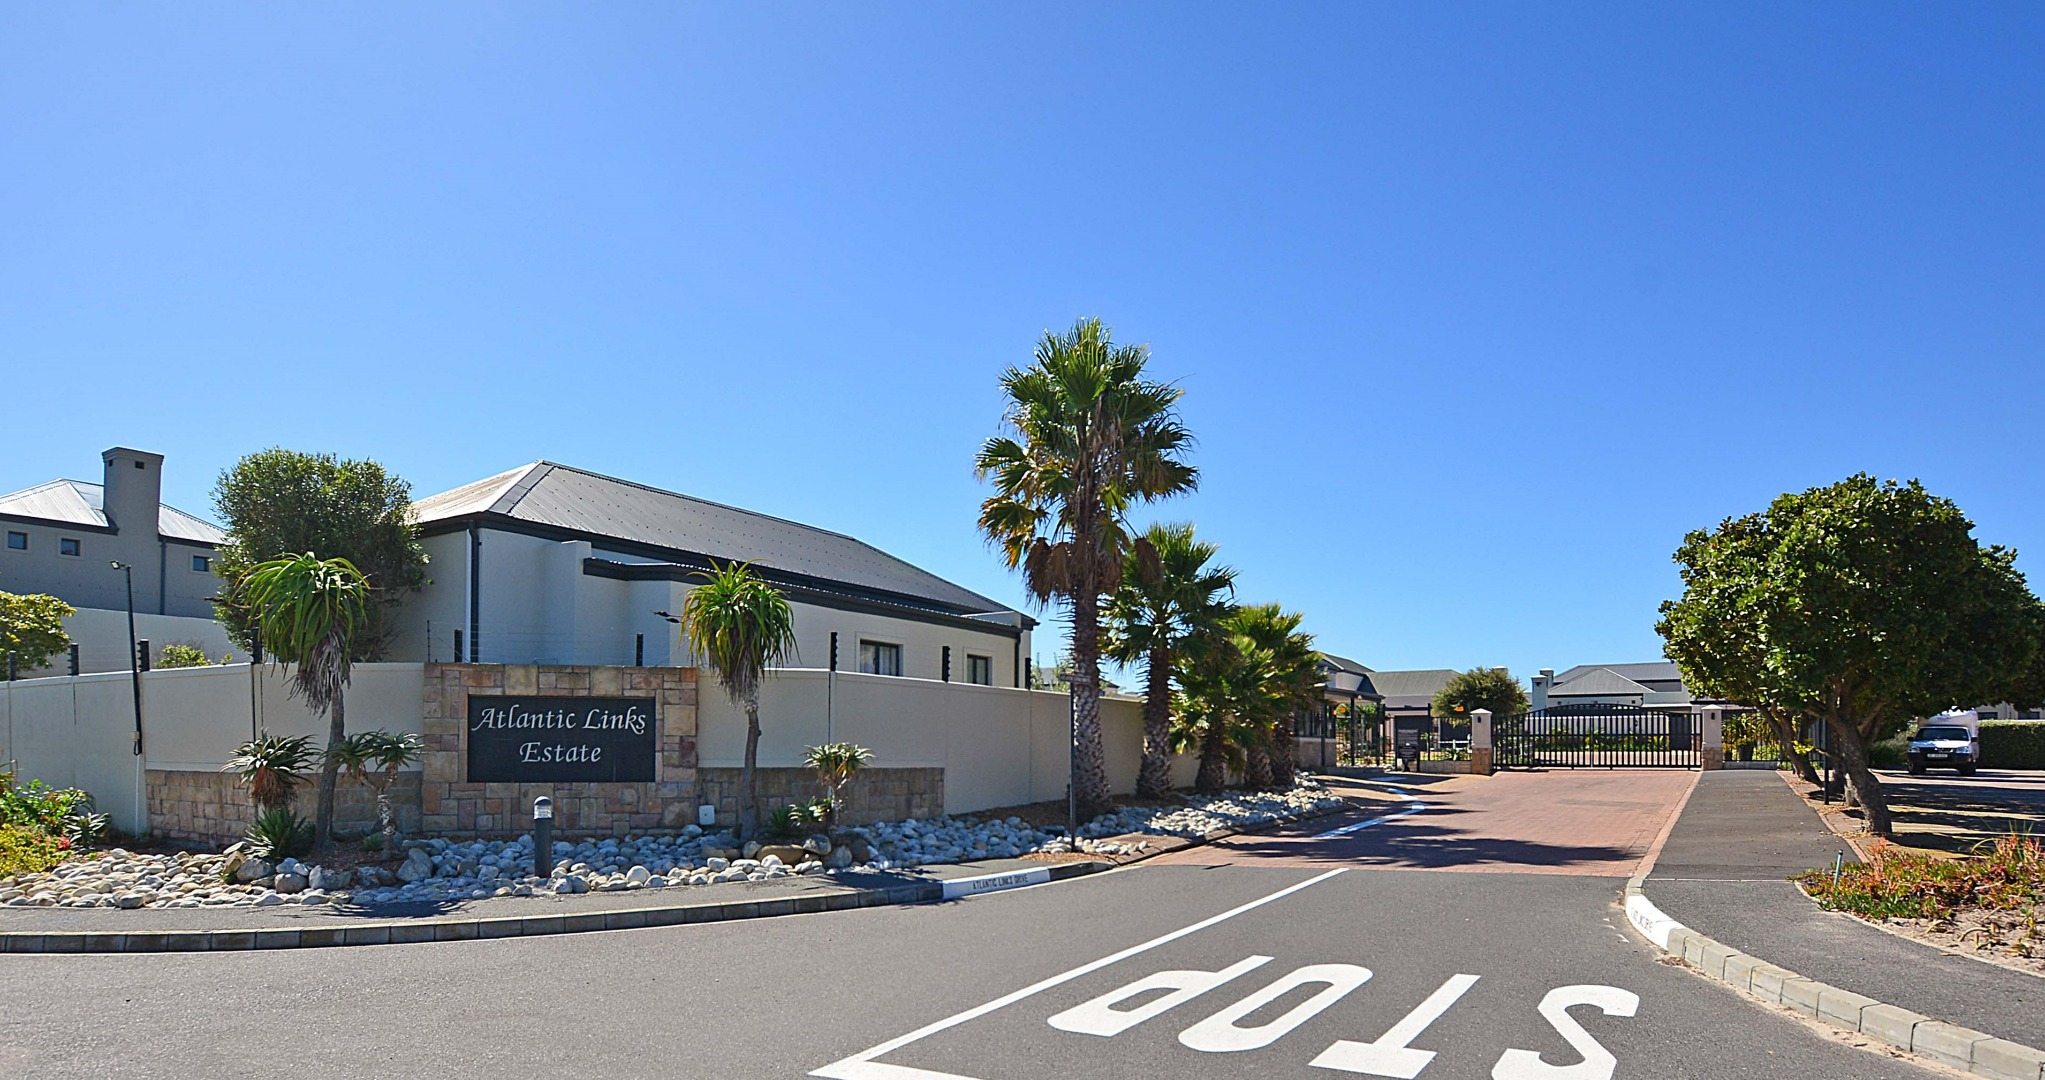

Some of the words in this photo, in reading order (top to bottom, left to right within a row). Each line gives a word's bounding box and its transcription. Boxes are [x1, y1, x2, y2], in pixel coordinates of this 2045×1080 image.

[471, 704, 577, 731] Atlantic
[582, 706, 646, 735] Links
[519, 741, 601, 763] Estate
[973, 877, 997, 890] ATLANTIC
[1046, 955, 1640, 1080] STOP
